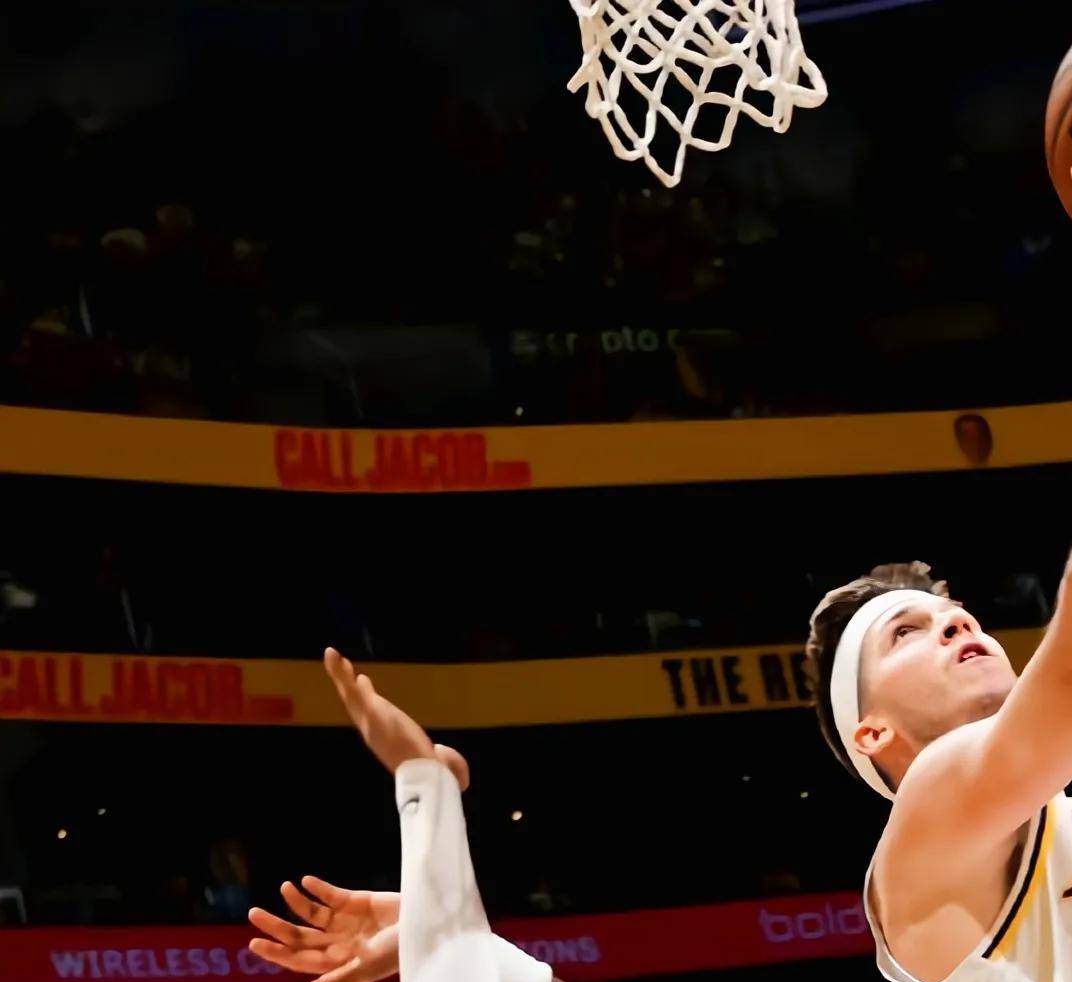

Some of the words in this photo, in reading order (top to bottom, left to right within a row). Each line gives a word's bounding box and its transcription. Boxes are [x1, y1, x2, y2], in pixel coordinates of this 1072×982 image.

[275, 429, 360, 488] CALL
[661, 655, 749, 709] THE
[52, 948, 230, 978] WIRELESS
